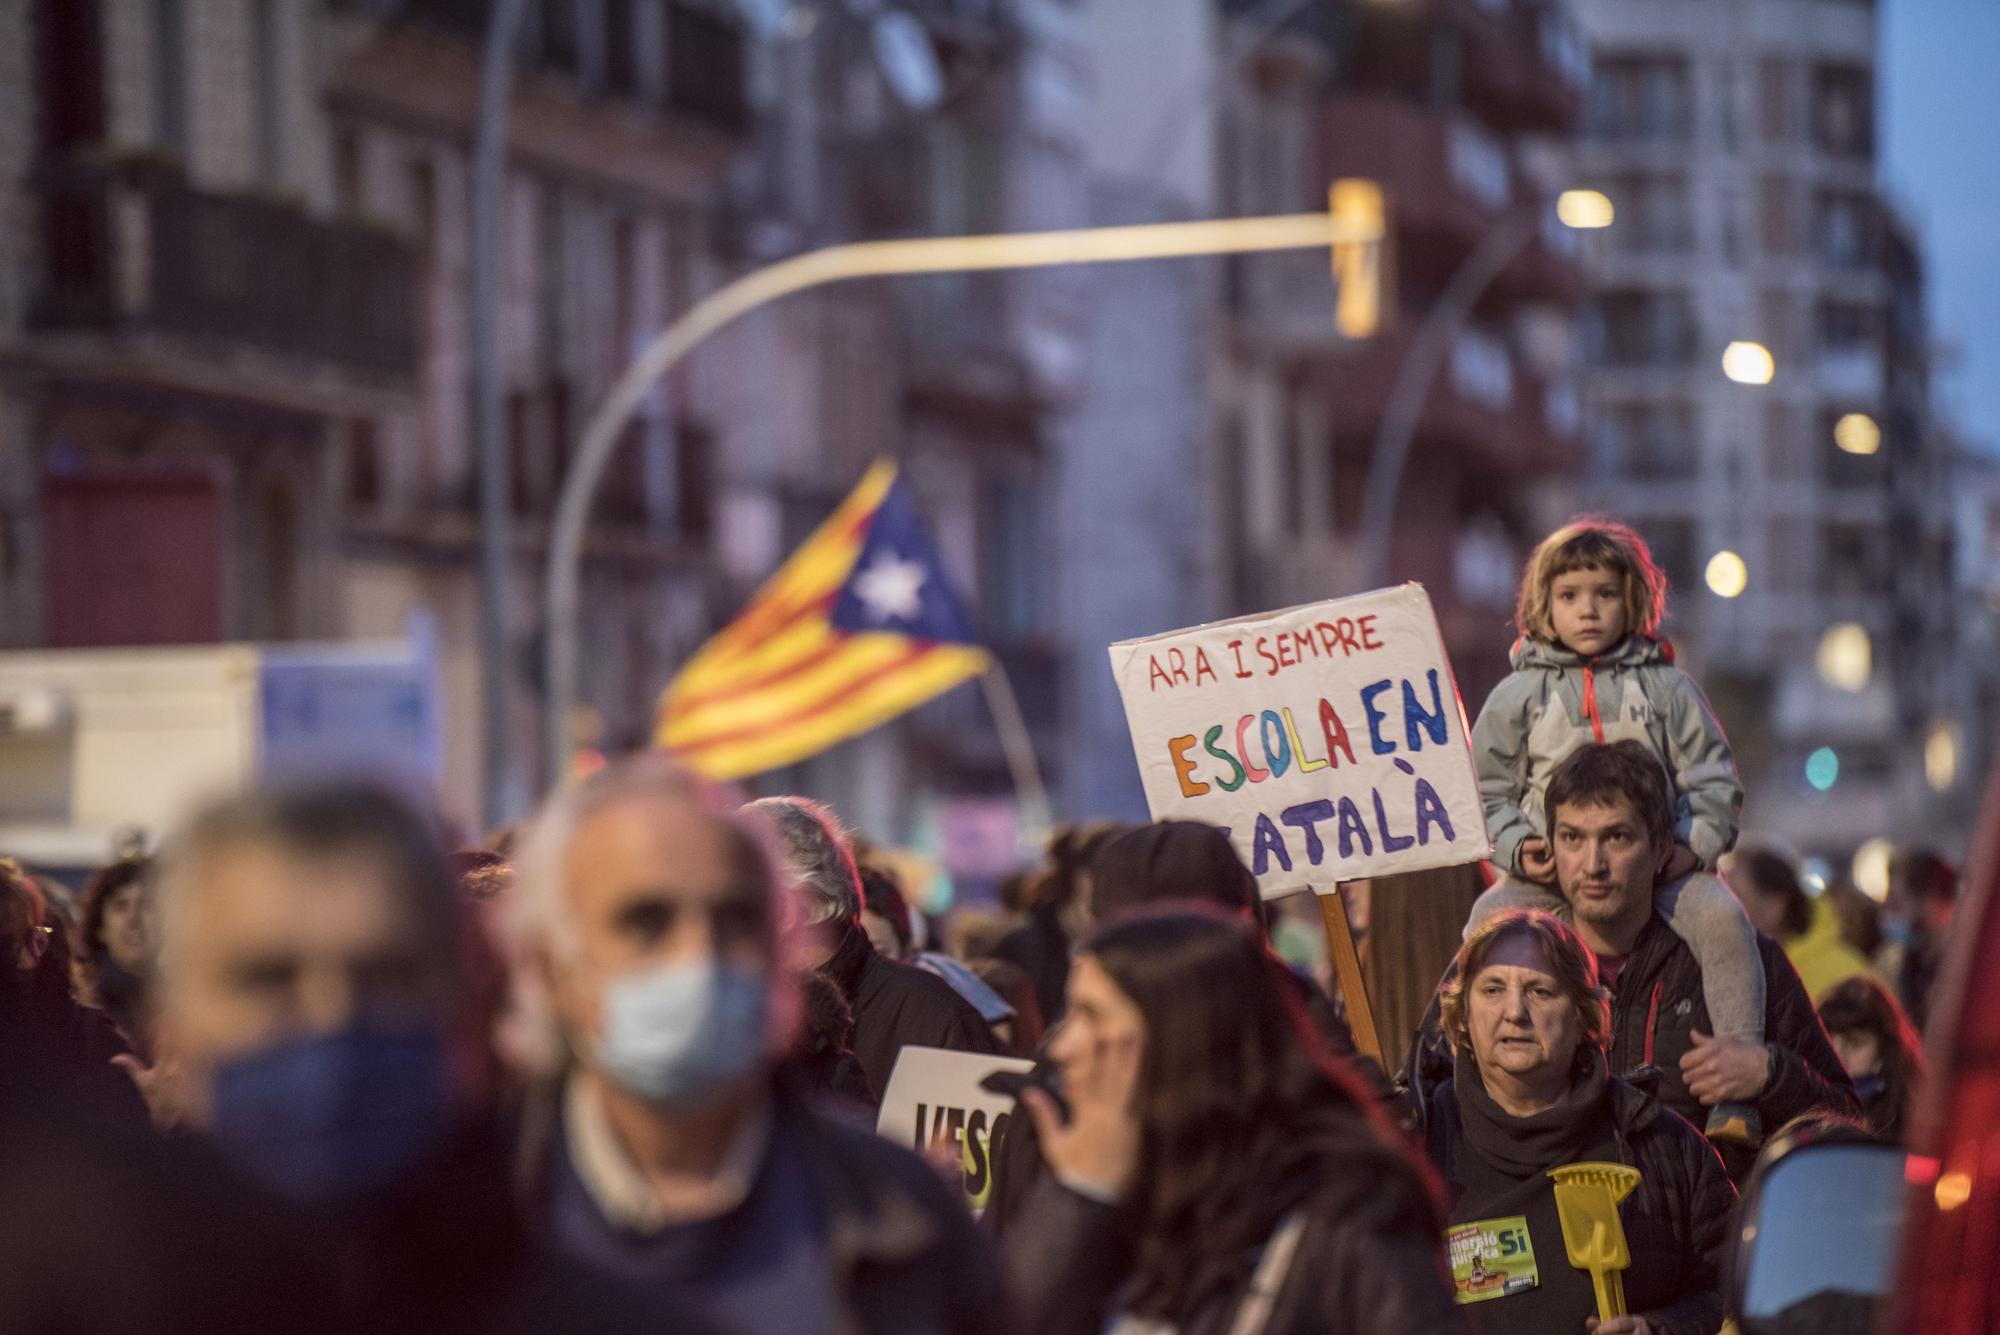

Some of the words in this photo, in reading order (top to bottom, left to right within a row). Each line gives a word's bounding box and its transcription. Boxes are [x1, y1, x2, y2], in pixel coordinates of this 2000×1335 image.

[1148, 645, 1217, 692] ARA
[1227, 640, 1253, 678] I
[1256, 614, 1385, 676] SEMPRE
[1168, 698, 1357, 798] ESCOLA
[1360, 668, 1448, 755] EN
[1217, 757, 1456, 876] ATALÀ
[1499, 1228, 1527, 1256] Sí
